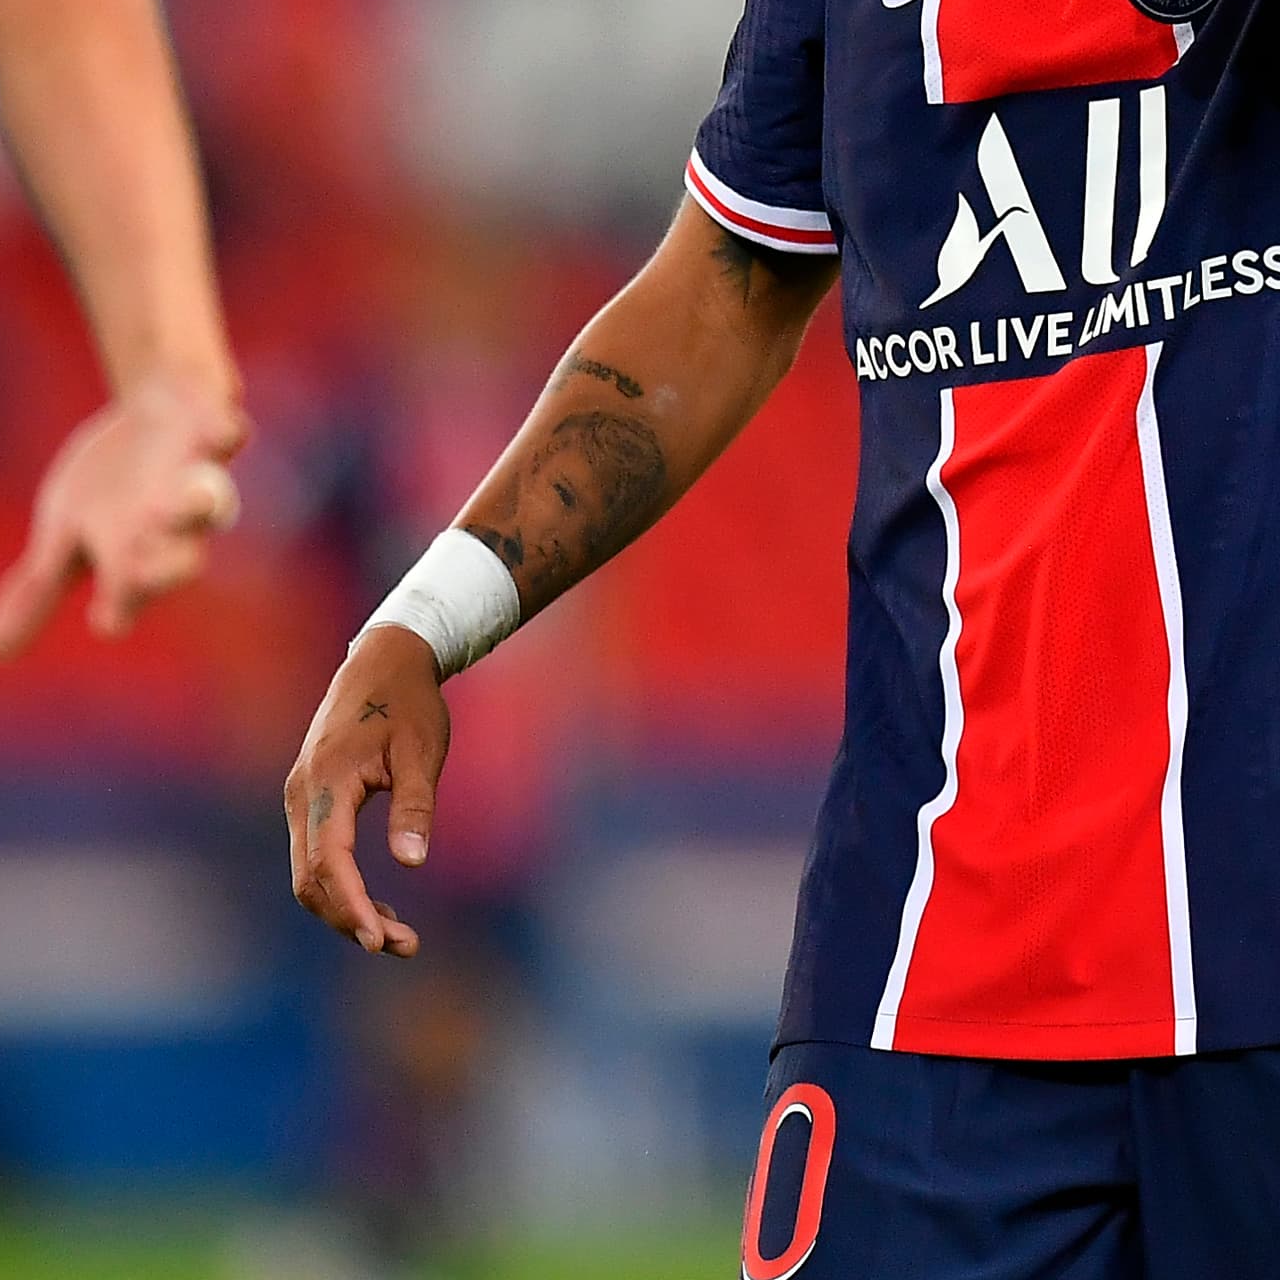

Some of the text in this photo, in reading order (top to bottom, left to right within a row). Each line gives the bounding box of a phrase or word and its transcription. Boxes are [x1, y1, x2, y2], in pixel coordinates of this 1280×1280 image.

[856, 325, 964, 382] ACCOR
[970, 311, 1073, 366] LIVE
[742, 1082, 837, 1280] 0
